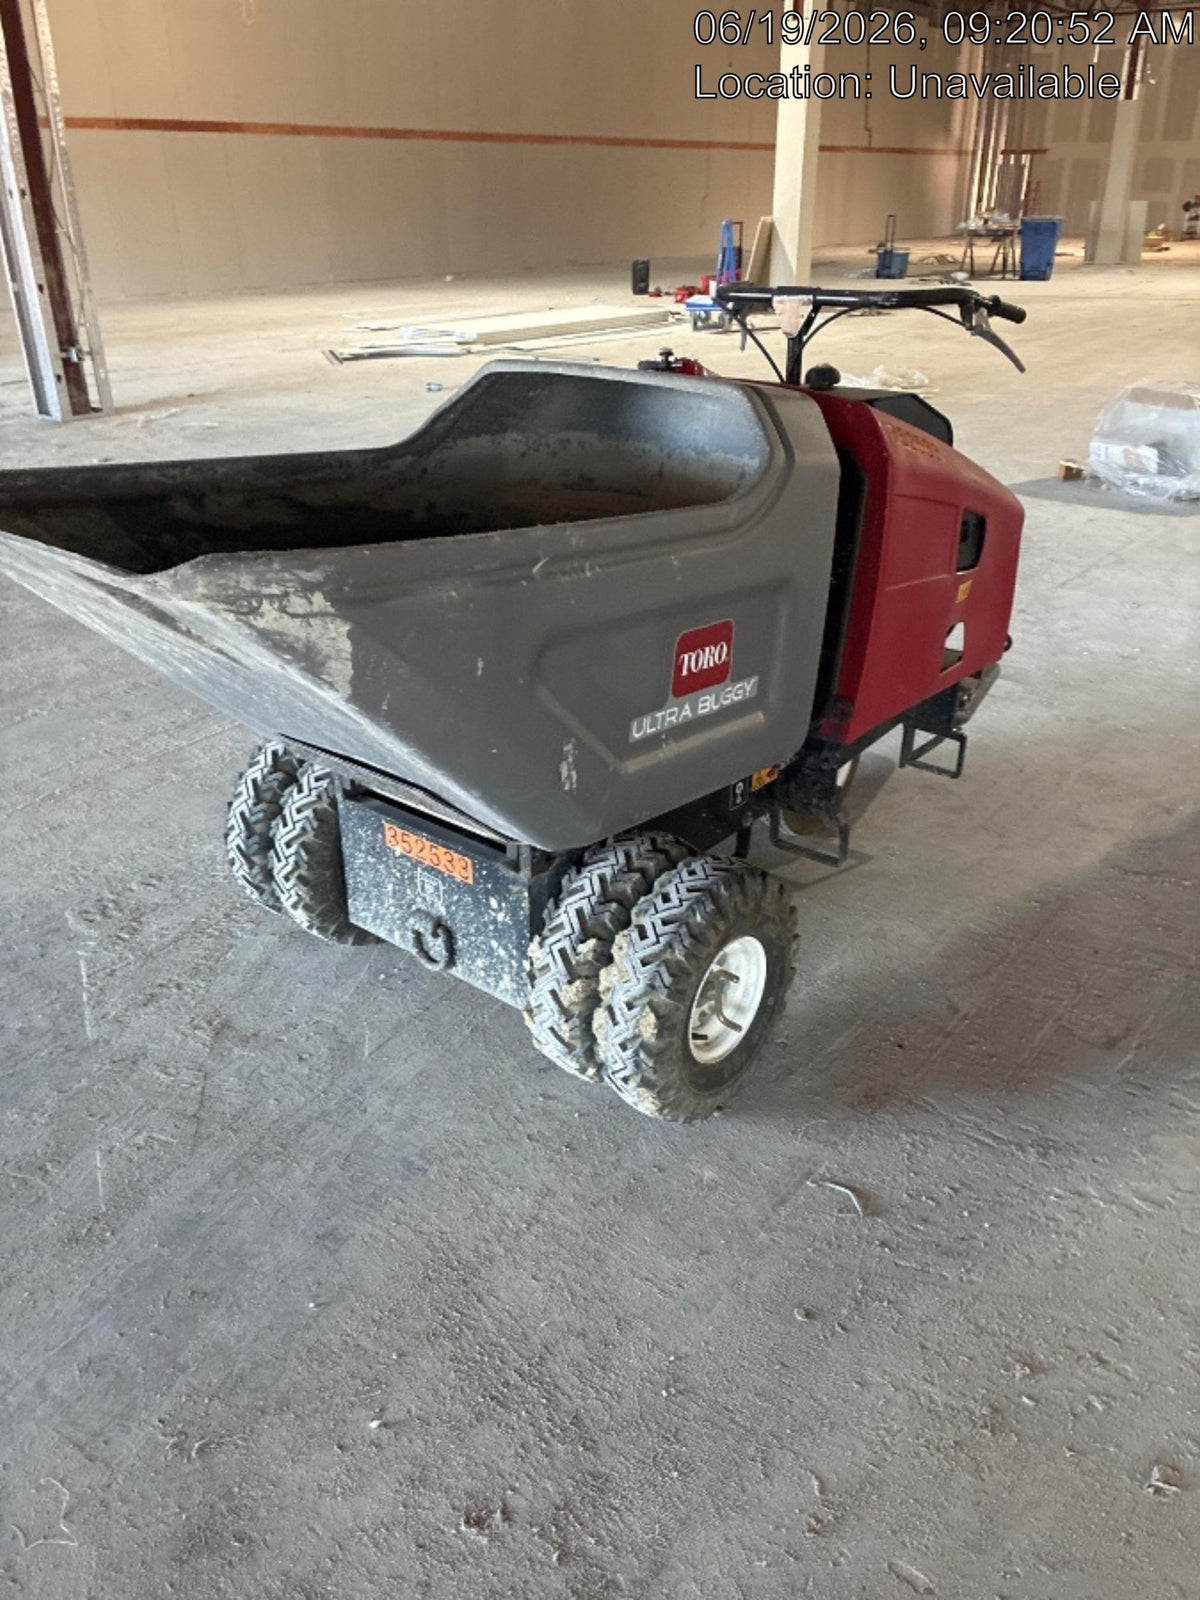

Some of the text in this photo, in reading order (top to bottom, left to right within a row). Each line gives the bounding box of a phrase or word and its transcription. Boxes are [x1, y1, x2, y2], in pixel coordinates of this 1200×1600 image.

[679, 641, 727, 677] TORO
[631, 678, 755, 738] ULTRA BUGGY
[386, 826, 469, 880] 352533
